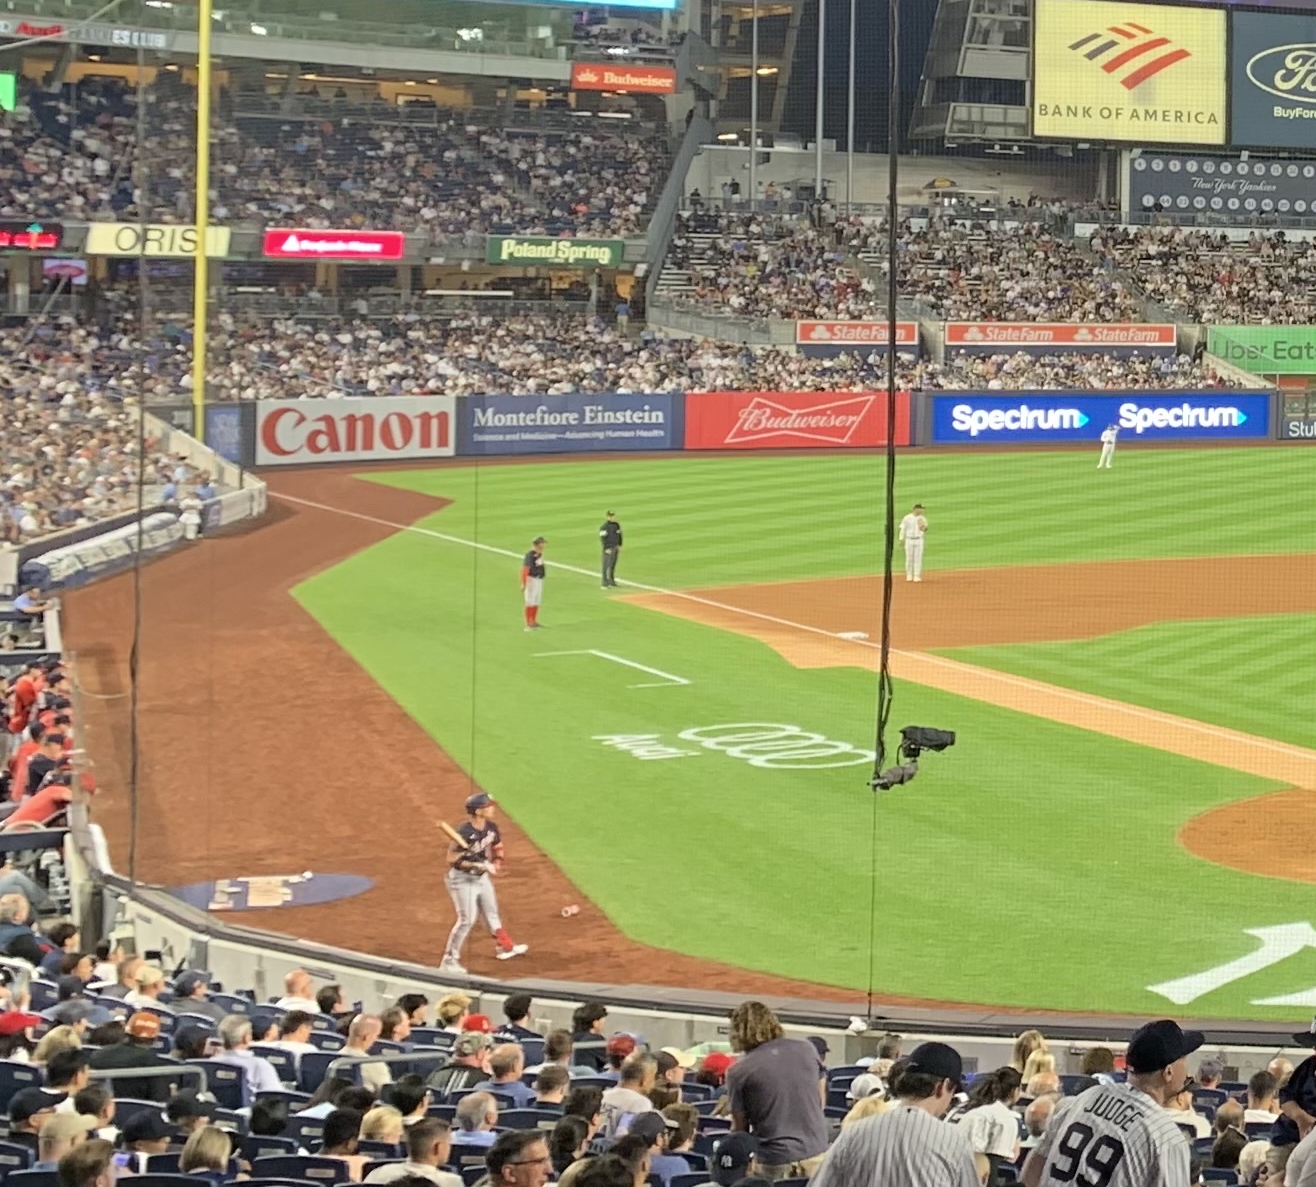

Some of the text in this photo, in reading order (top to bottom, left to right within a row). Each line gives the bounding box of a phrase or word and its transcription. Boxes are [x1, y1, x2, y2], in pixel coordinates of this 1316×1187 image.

[604, 72, 673, 87] Budweiser
[1039, 103, 1219, 125] BANK OF AMERICA
[115, 226, 198, 254] ORIS
[501, 238, 611, 263] Poland Spring
[1213, 341, 1267, 360] Uber
[473, 404, 664, 429] Montefiore Einstein
[740, 405, 858, 431] Budweiser
[952, 403, 1237, 436] Spectrum Spectrum
[261, 406, 449, 457] Canon
[591, 733, 699, 760] Audi
[1084, 1093, 1145, 1132] JUDGE
[1050, 1122, 1125, 1187] 99
